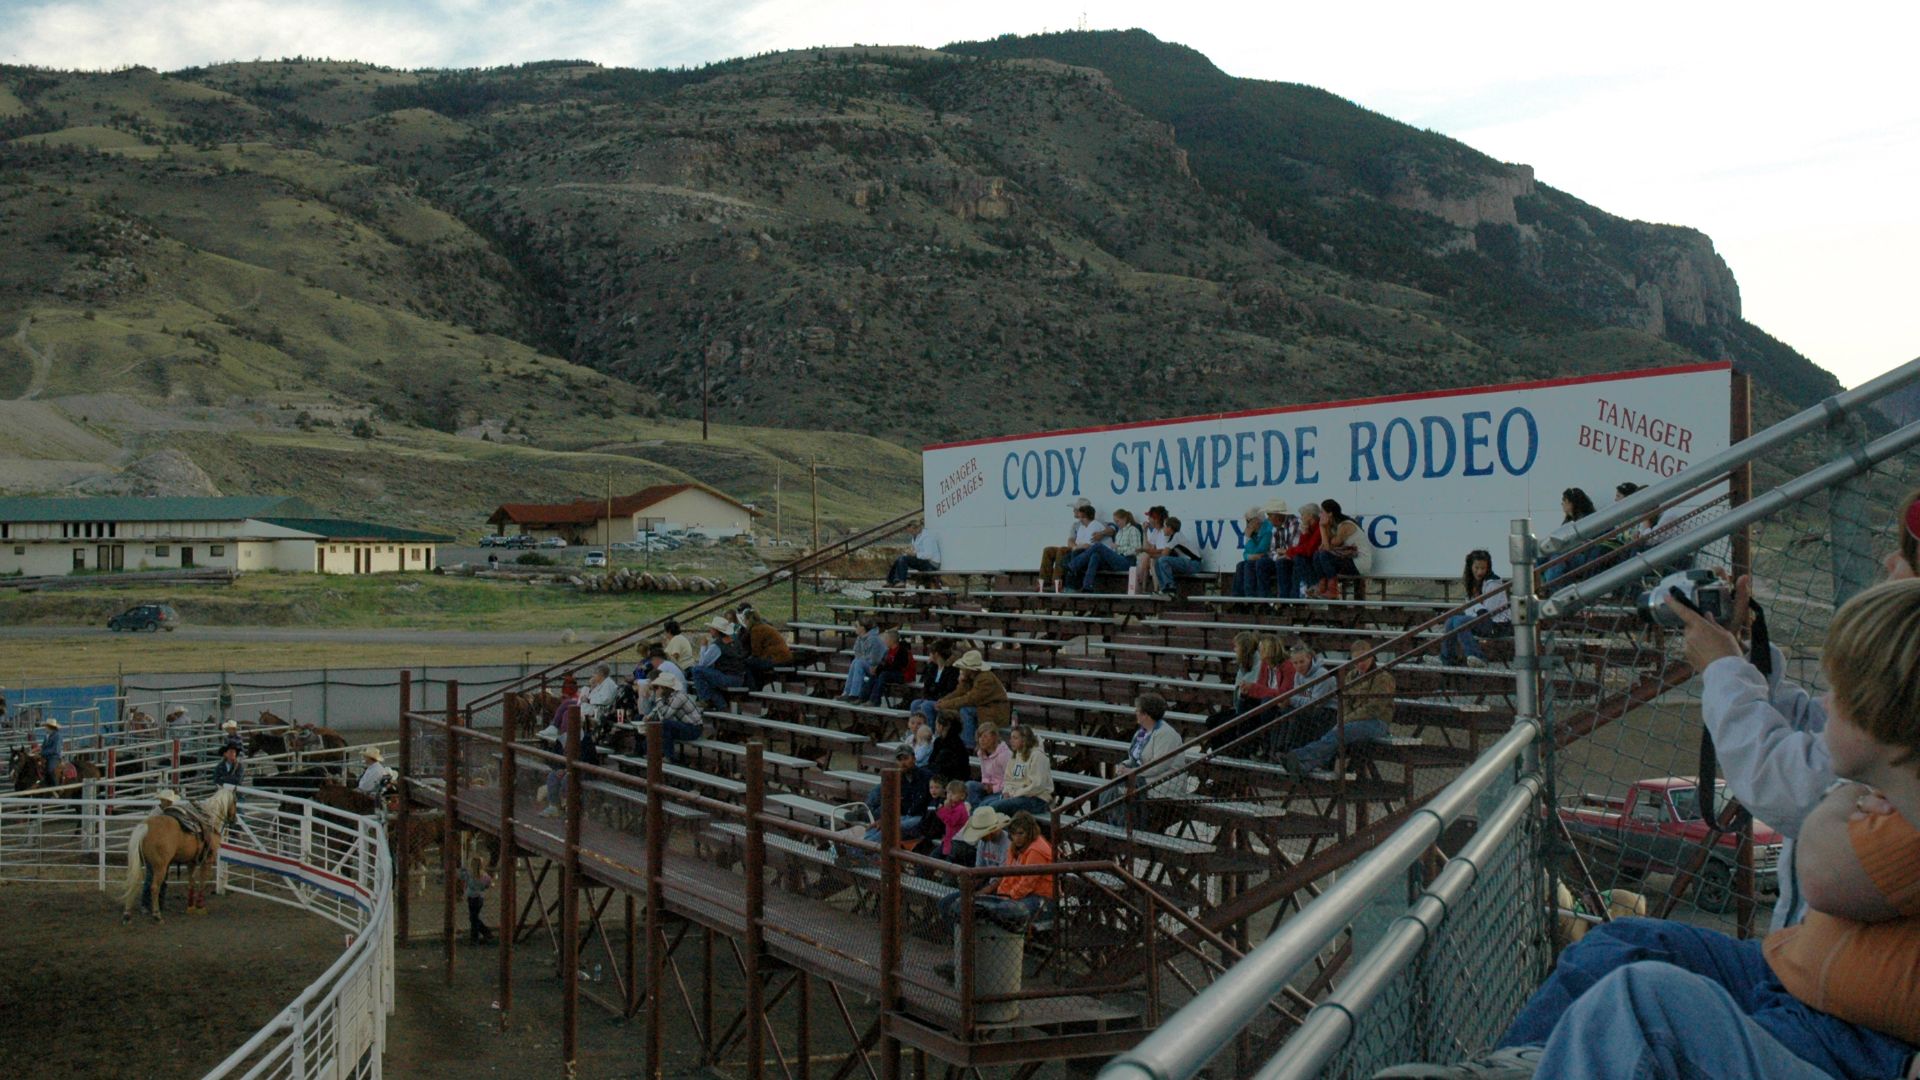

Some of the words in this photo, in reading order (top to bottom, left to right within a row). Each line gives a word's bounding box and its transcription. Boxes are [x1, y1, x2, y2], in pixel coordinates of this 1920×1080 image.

[1598, 398, 1693, 454] TANAGER
[939, 457, 978, 495] TANAGER
[1003, 446, 1086, 500] CODY
[1110, 426, 1319, 495] STAMPEDE
[1349, 406, 1539, 482] RODEO
[935, 471, 984, 518] BEVERAGES
